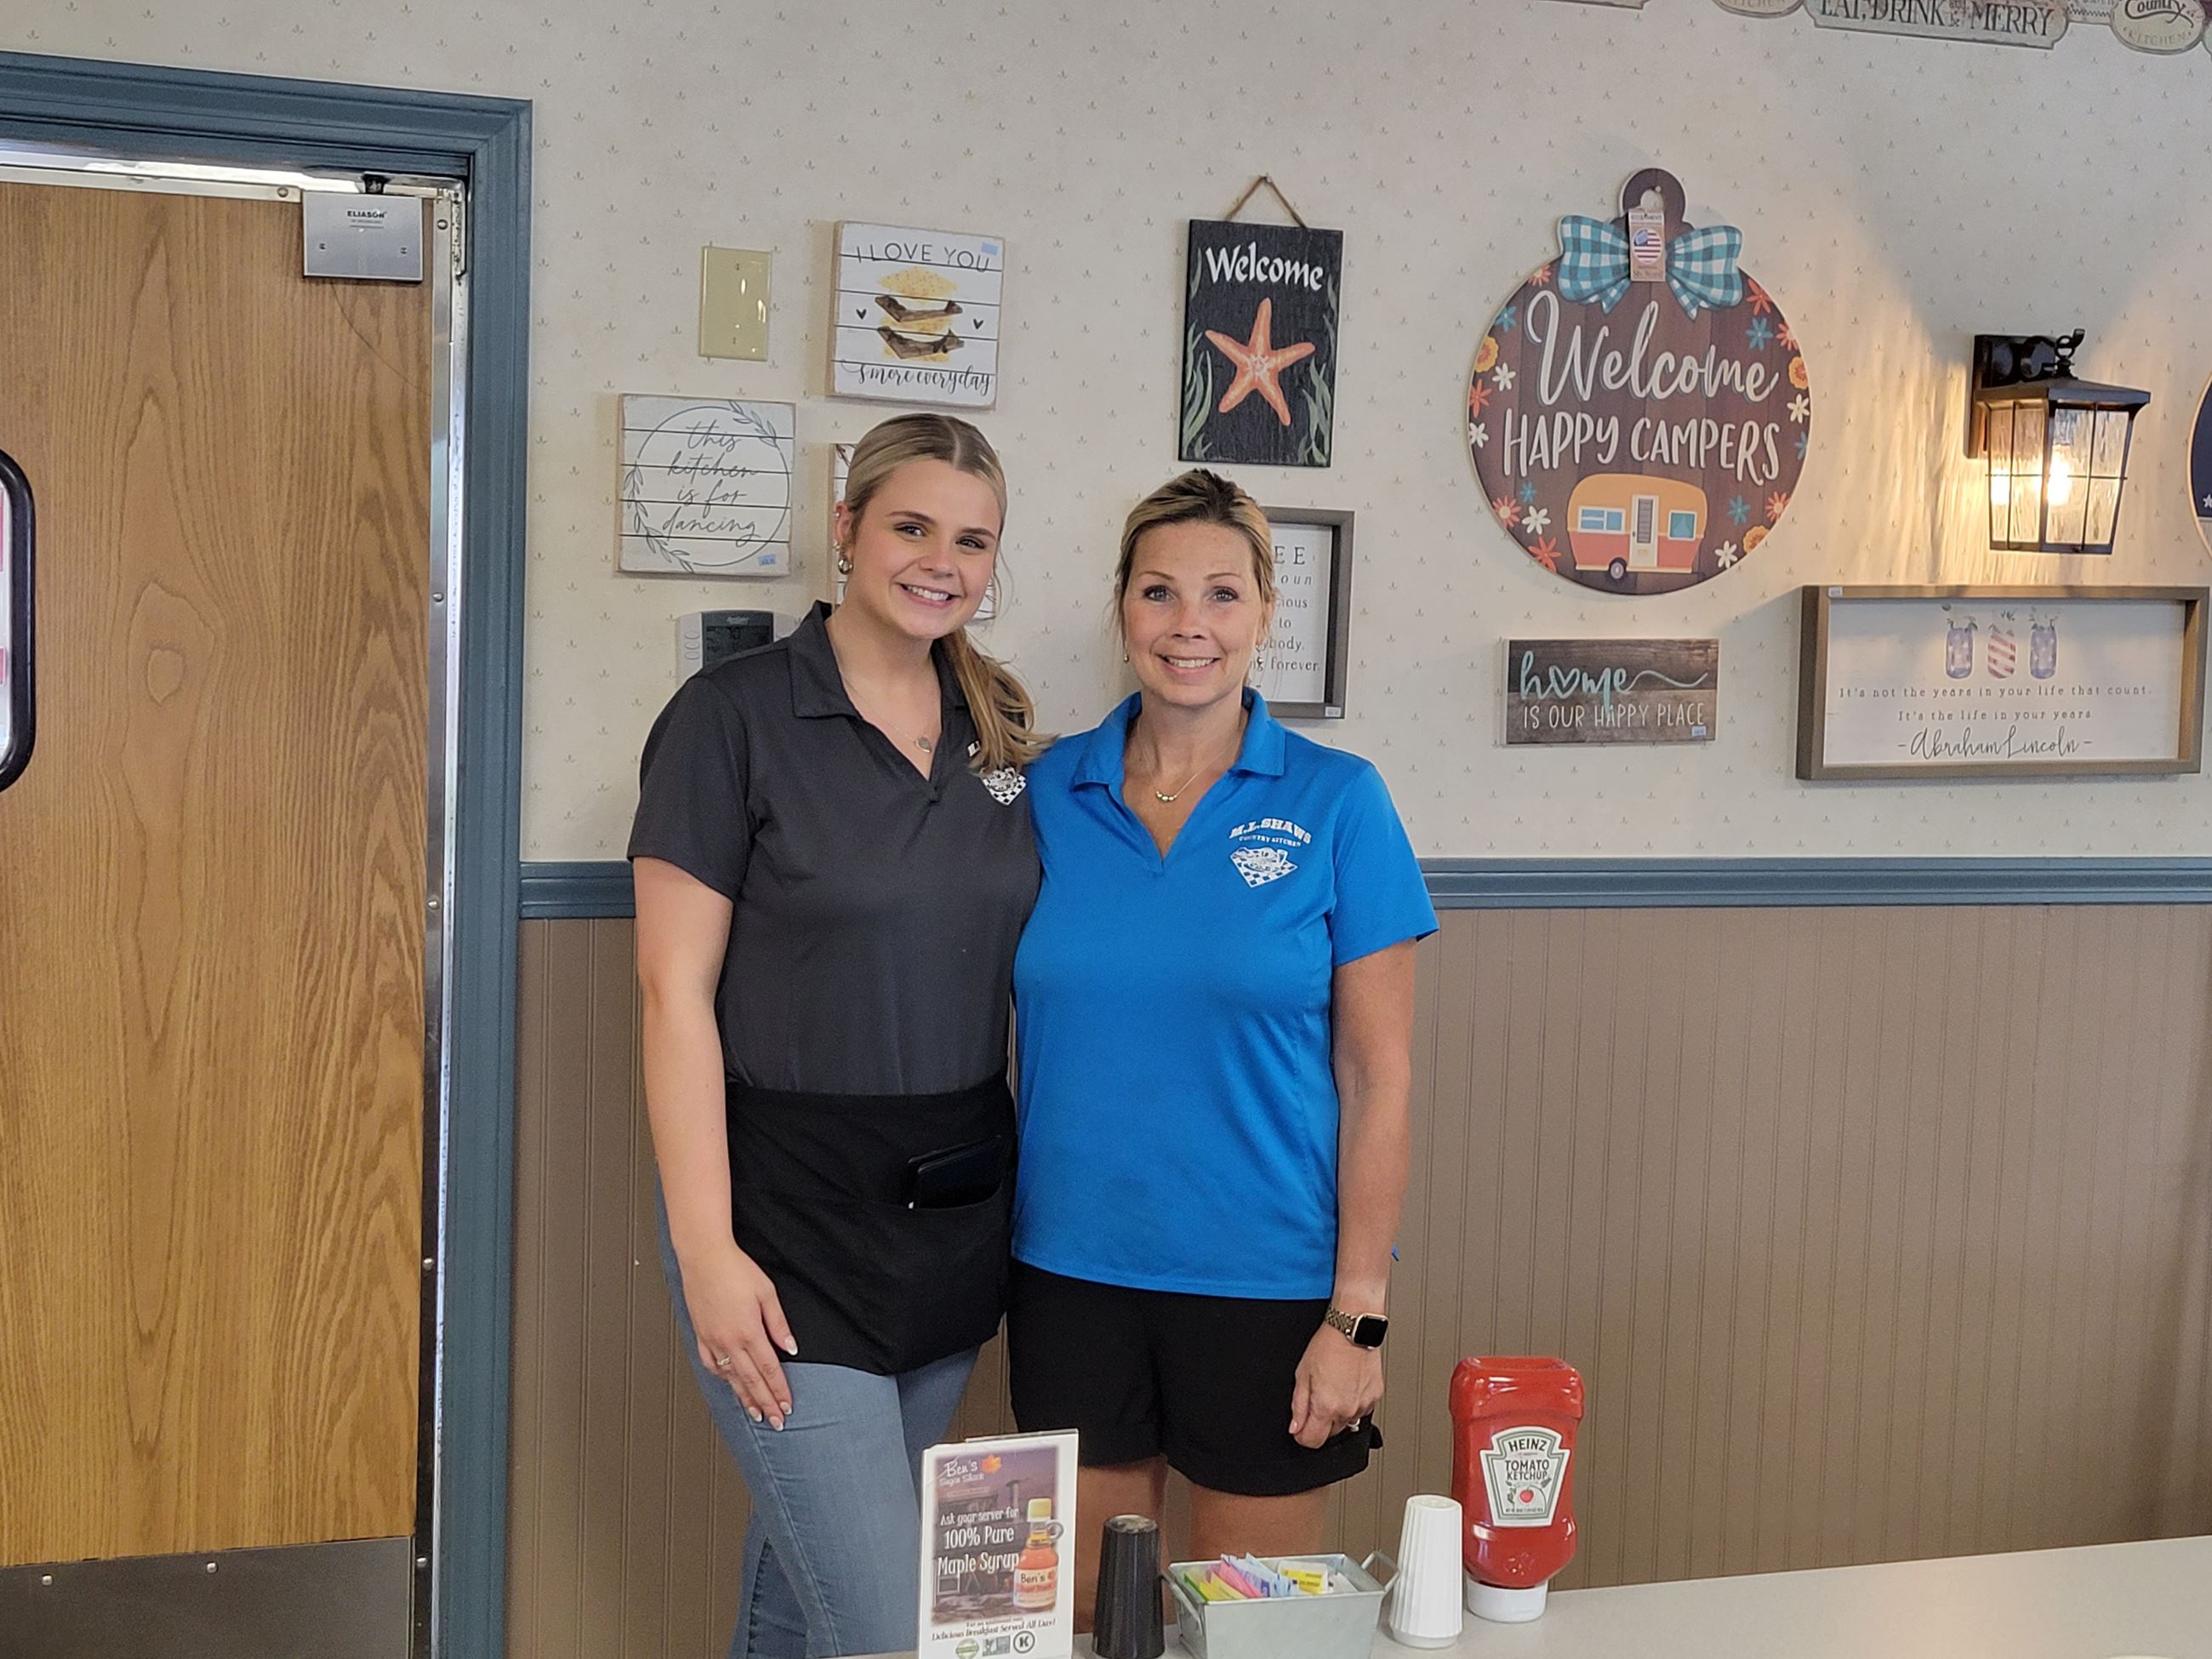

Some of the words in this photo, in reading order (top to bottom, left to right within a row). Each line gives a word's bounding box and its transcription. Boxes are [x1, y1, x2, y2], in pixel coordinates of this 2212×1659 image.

[1871, 0, 1947, 26] DRINK
[1970, 1, 2055, 37] MERRY
[347, 210, 385, 219] ELIASON
[856, 245, 862, 264] I
[869, 242, 933, 262] LOVE
[944, 246, 990, 273] YOU
[1204, 241, 1324, 291] Welcome
[1525, 290, 1779, 406] Welcome
[916, 365, 991, 396] everyday
[685, 419, 742, 453] this
[1503, 408, 1620, 477] HAPPY
[1630, 416, 1782, 487] CAMPERS
[667, 450, 759, 485] kitchen
[677, 485, 700, 507] is
[703, 478, 748, 519] for
[662, 505, 762, 548] dancing
[1839, 687, 1866, 698] It's
[1873, 687, 1896, 698] not
[1903, 687, 1926, 698] the
[1932, 687, 1972, 699] years
[1979, 687, 1993, 697] in
[1998, 687, 2032, 698] your
[2038, 685, 2065, 696] life
[2071, 685, 2101, 696] that
[1524, 704, 1540, 729] IS
[1548, 704, 1586, 728] OUR
[1593, 703, 1650, 728] HAPPY
[1657, 702, 1705, 727] PLACE
[1898, 710, 1924, 721] It's
[1931, 710, 1954, 721] the
[1960, 709, 1988, 721] life
[1993, 710, 2008, 721] in
[2014, 710, 2046, 721] your
[1508, 1438, 1548, 1452] HEINZ
[940, 1456, 979, 1478] Ben's
[1505, 1459, 1550, 1472] TOMATO
[1507, 1470, 1548, 1481] KETCHUP
[939, 1512, 956, 1526] Ask
[978, 1509, 1004, 1522] server
[1005, 1505, 1020, 1519] for
[944, 1525, 981, 1550] 100%
[983, 1525, 1015, 1546] Pure
[938, 1554, 977, 1579] Maple
[978, 1551, 1019, 1575] Syrup
[1020, 1572, 1046, 1584] Ben's
